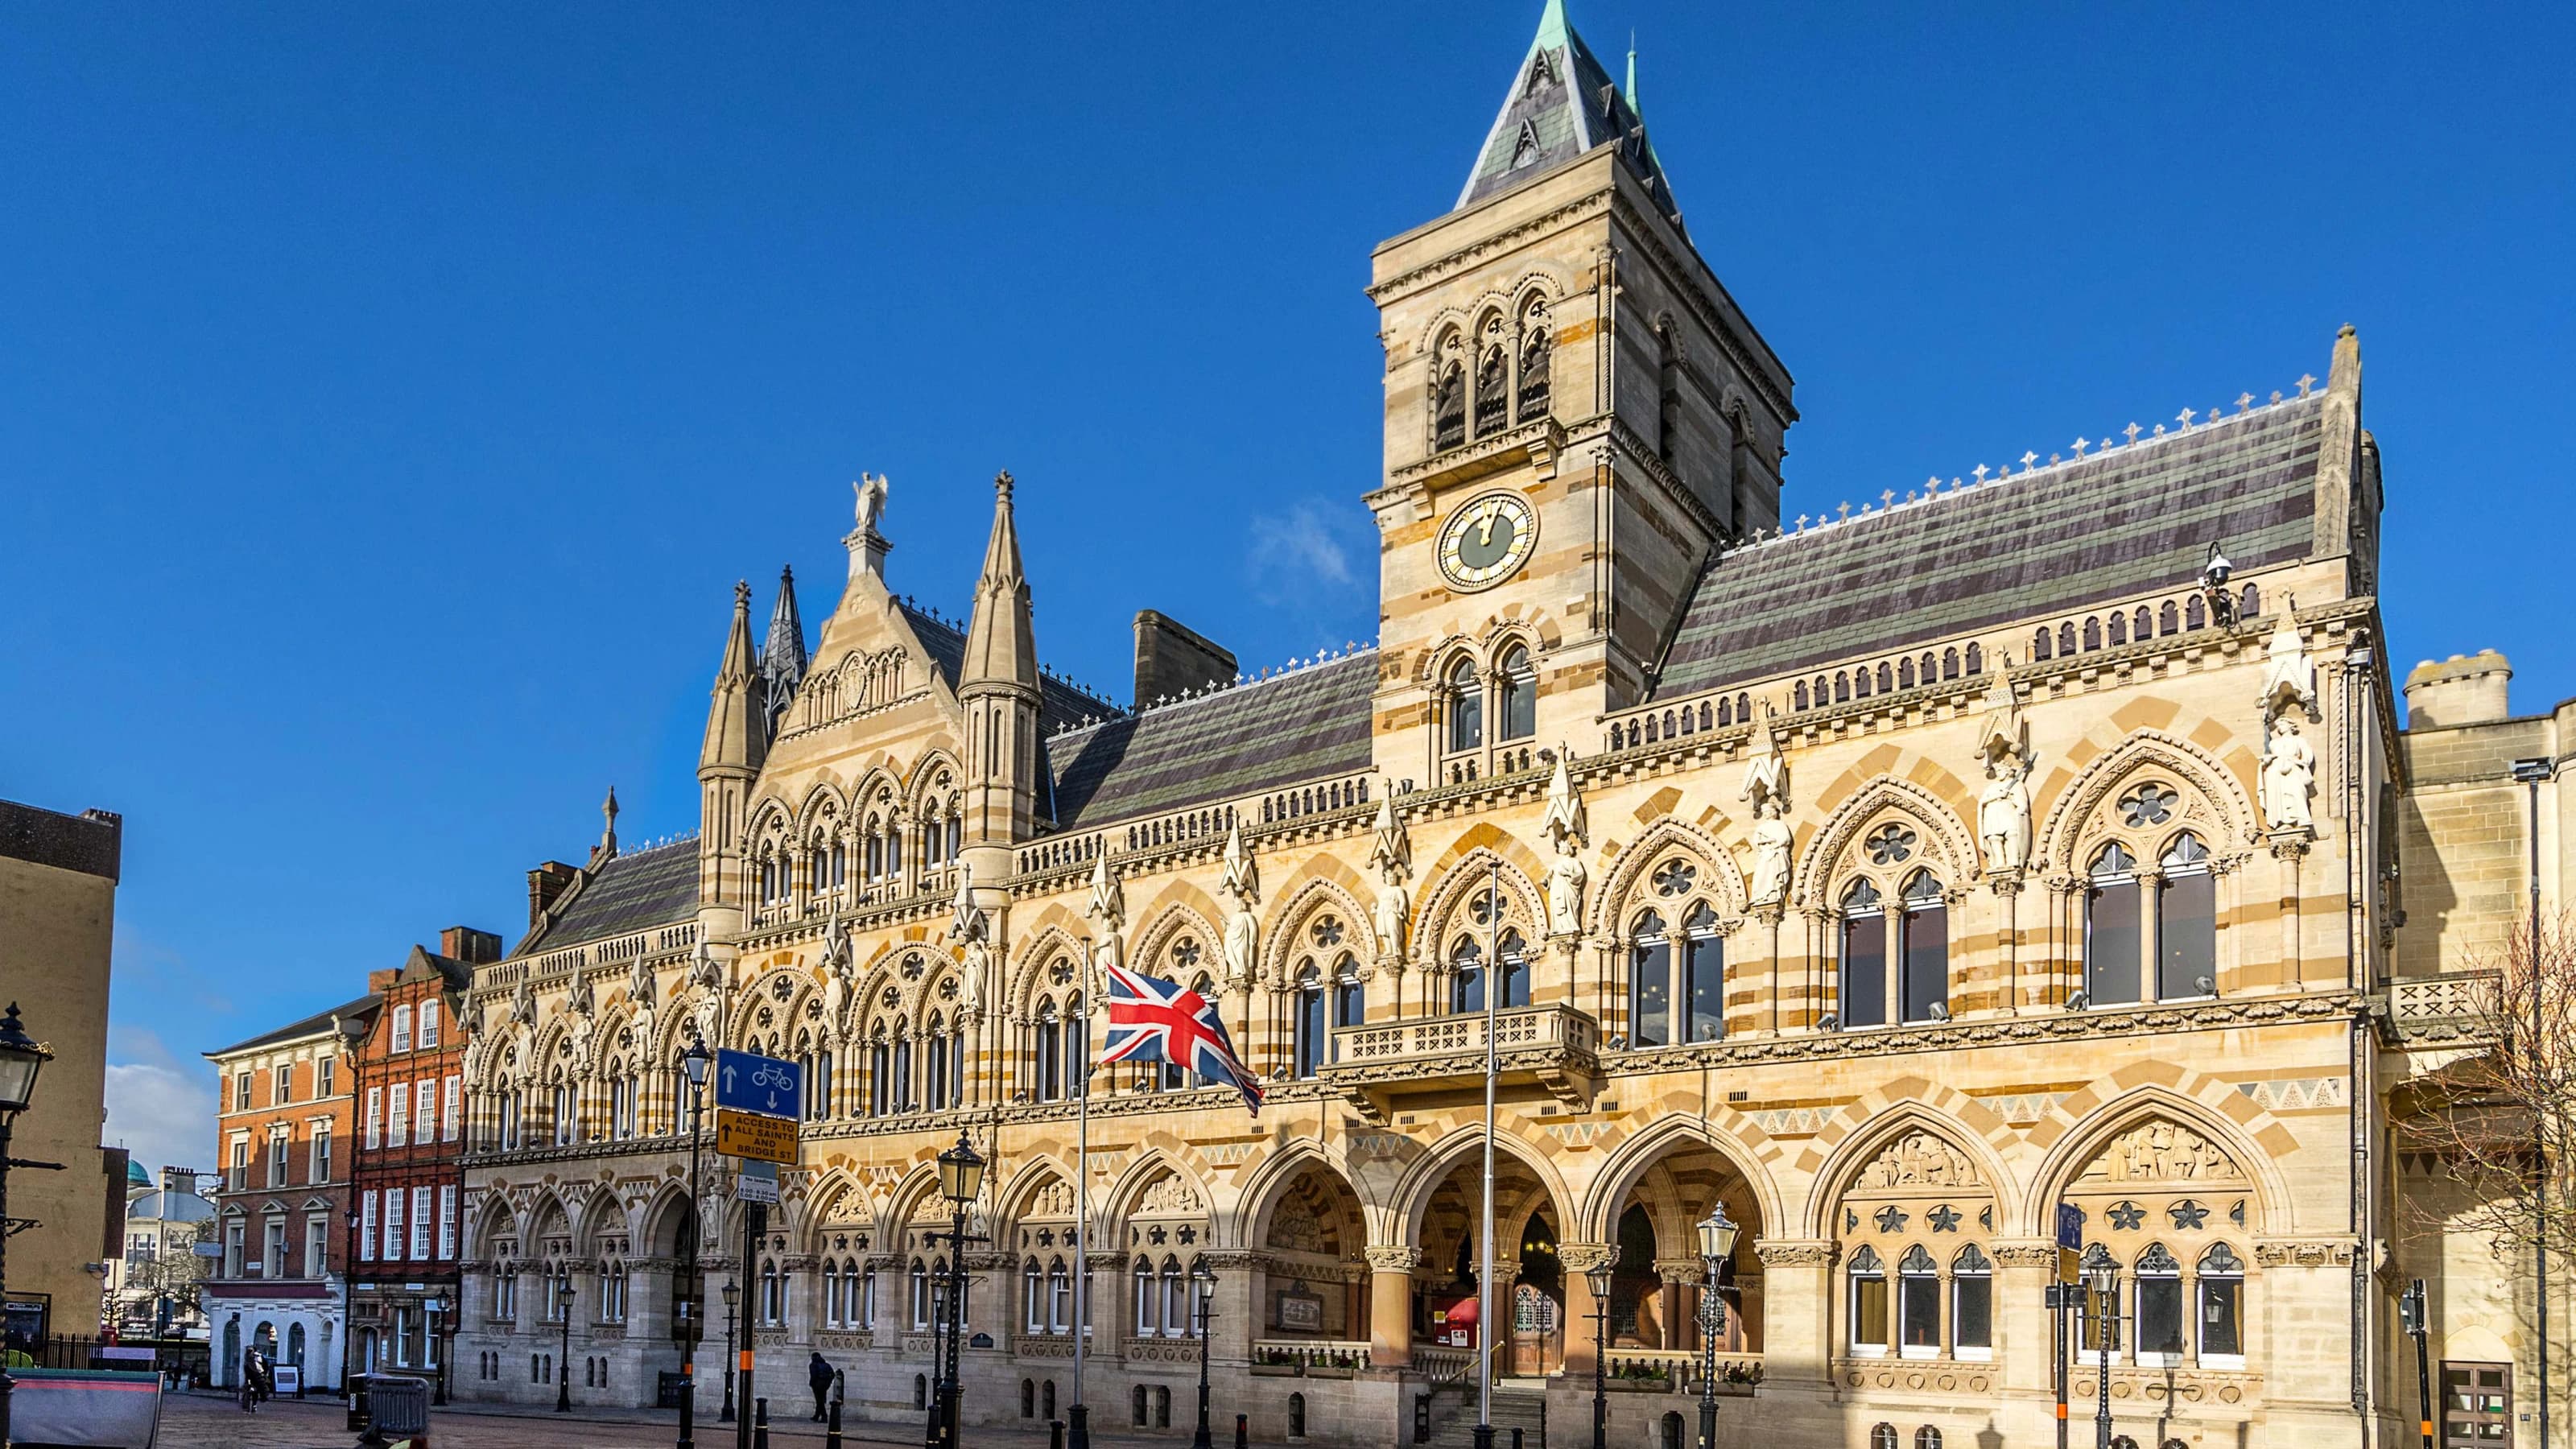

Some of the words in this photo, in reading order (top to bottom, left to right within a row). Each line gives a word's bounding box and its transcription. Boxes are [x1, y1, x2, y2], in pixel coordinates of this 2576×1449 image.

[736, 1117, 778, 1129] ACCESS
[781, 1123, 794, 1133] TO
[735, 1125, 753, 1135] ALL
[758, 1129, 794, 1141] SAINTS
[753, 1138, 776, 1148] AND
[737, 1145, 775, 1157] BRIDGE
